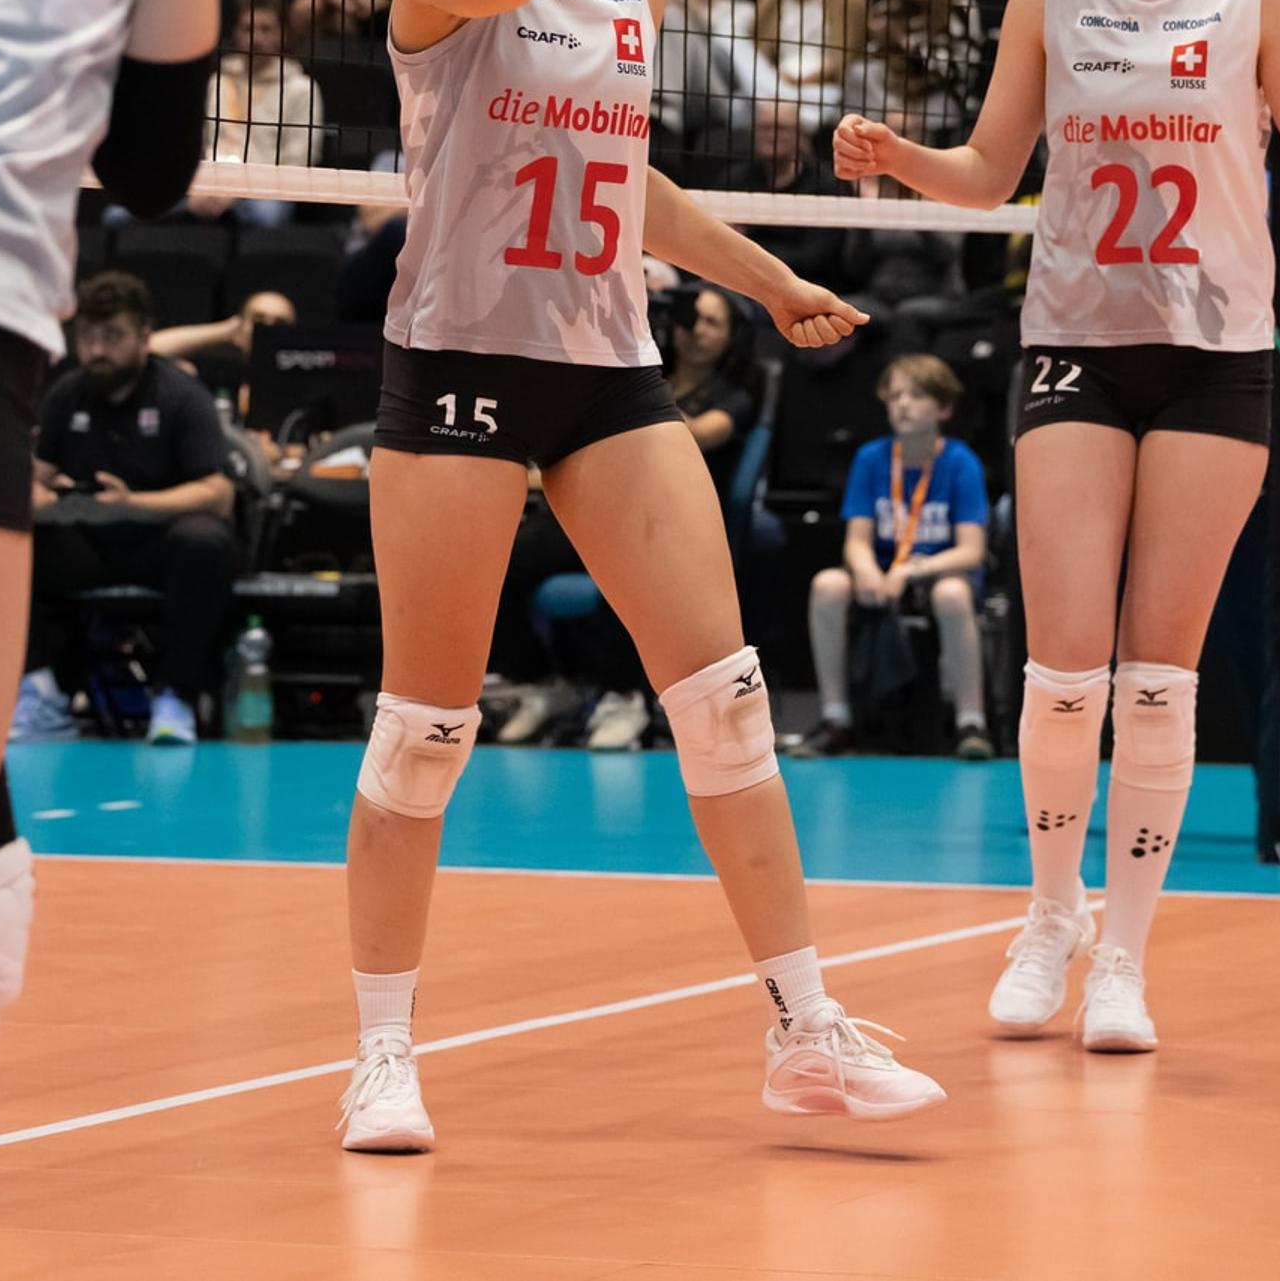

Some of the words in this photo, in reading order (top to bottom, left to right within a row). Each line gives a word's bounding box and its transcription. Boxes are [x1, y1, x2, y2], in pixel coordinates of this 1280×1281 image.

[516, 26, 568, 48] CRAFT
[1079, 15, 1140, 33] CONCORDIA
[616, 62, 647, 77] SUISSE
[1072, 61, 1121, 73] CRAFT
[1170, 78, 1207, 90] SUISSE
[487, 88, 541, 126] die
[1063, 116, 1095, 144] die
[1100, 114, 1223, 144] Mobiliar
[504, 156, 629, 276] 15
[1091, 164, 1200, 266] 22
[1030, 355, 1082, 394] 22
[436, 393, 498, 434] 15
[430, 424, 476, 440] CRAFT
[765, 978, 788, 1014] CRAFT
